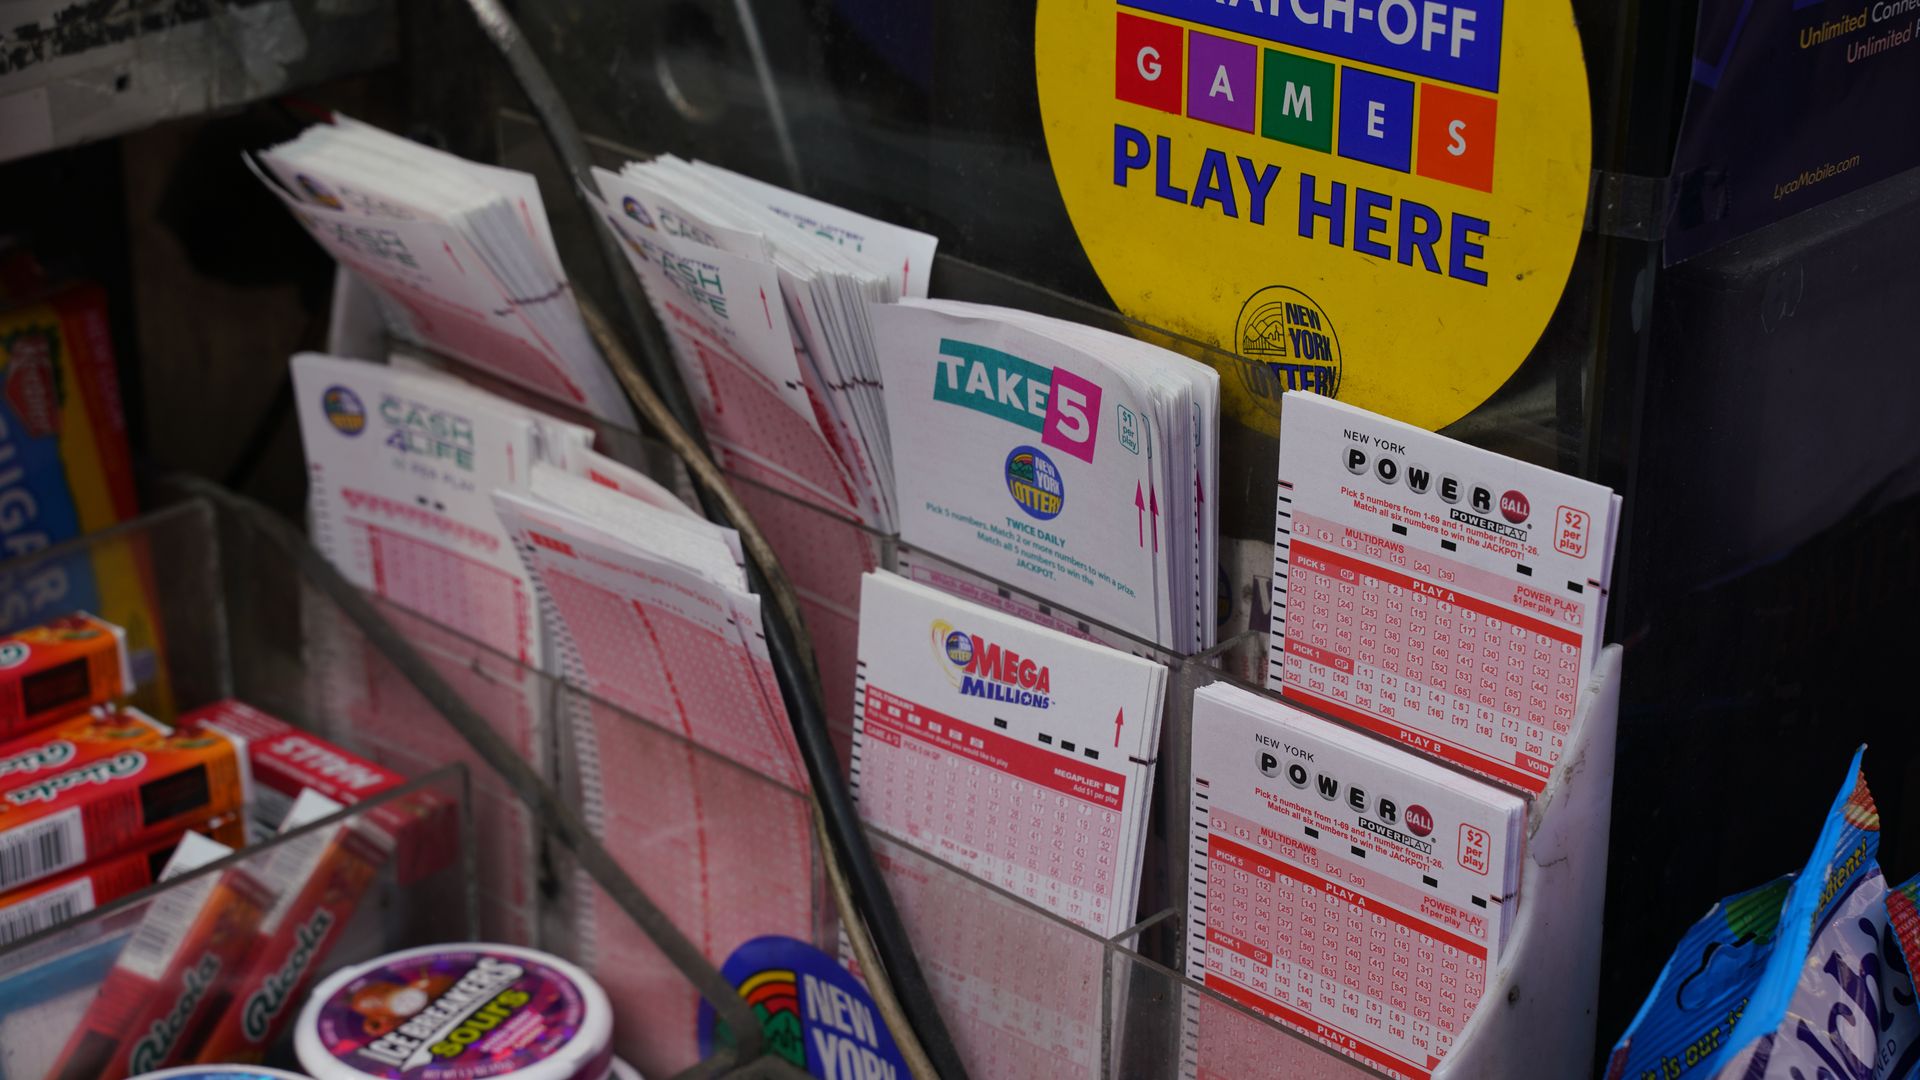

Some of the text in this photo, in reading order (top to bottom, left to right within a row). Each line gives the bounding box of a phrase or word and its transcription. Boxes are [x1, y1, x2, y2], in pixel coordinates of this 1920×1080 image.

[1800, 0, 1920, 49] Unlimited Conne
[1846, 21, 1913, 64] Unlimited
[1773, 153, 1860, 200] LycaMobile.com
[1113, 123, 1490, 287] PLAY HERE
[1285, 302, 1322, 332] NEW
[1288, 328, 1333, 362] YORK
[1122, 410, 1133, 427] $1
[1121, 434, 1138, 451] play
[1122, 426, 1135, 439] per
[1343, 428, 1406, 455] NEW YORK
[1034, 456, 1056, 478] NEW
[1036, 470, 1061, 496] YORK
[1009, 479, 1063, 515] LOTTERY
[1005, 516, 1066, 548] TWICE DAILY
[1341, 486, 1358, 498] Pick
[1359, 492, 1366, 501] 5
[1366, 495, 1401, 511] numbers
[1403, 505, 1421, 518] from
[1423, 512, 1440, 524] 1-69
[1442, 518, 1457, 530] and
[1466, 526, 1498, 543] number
[1499, 536, 1519, 549] from
[1521, 543, 1540, 557] 1-26.
[1353, 500, 1525, 562] Match all six numbers to win the JACKPOT!
[1564, 511, 1583, 530] $2
[1344, 527, 1405, 554] MULTIDRAWS
[1559, 539, 1582, 554] play
[1562, 528, 1582, 541] per
[1021, 549, 1056, 570] numbers
[1057, 563, 1066, 573] to
[1032, 541, 1053, 555] more
[1054, 549, 1088, 572] numbers
[1088, 565, 1097, 576] to
[1097, 571, 1112, 584] win
[1297, 556, 1320, 569] PICK
[1320, 563, 1326, 571] 5
[1412, 580, 1456, 604] PLAY A
[1516, 585, 1579, 613] POWER PLAY
[1538, 602, 1556, 617] play
[963, 633, 1051, 695] MEGA
[1292, 643, 1314, 658] PICK
[960, 675, 1051, 709] MILLIONS
[1255, 733, 1316, 763] NEW YORK
[1400, 731, 1442, 753] PLAY B
[1526, 758, 1549, 773] VOID
[1073, 784, 1086, 793] Add
[1086, 788, 1094, 796] $1
[1094, 791, 1105, 800] per
[1255, 787, 1271, 800] Pick
[1272, 794, 1278, 803] 5
[1279, 797, 1313, 816] numbers
[1314, 810, 1332, 824] from
[1333, 818, 1349, 832] 1-69
[1351, 826, 1366, 838] and
[1374, 835, 1404, 853] number
[1405, 846, 1424, 862] from
[1426, 856, 1445, 871] 1-26.
[1260, 826, 1317, 856] MULTIDRAWS
[1267, 801, 1431, 873] Match all six numbers to win the JACKPOT!
[1466, 829, 1484, 848] $2
[1216, 850, 1244, 867] PICK 5
[1462, 854, 1485, 871] play
[1465, 846, 1483, 858] per
[1325, 883, 1366, 907] PLAY A
[1423, 896, 1483, 926] POWER PLAY
[1444, 914, 1461, 929] play
[1214, 932, 1234, 947] PICK
[242, 906, 335, 1042] Ricola
[130, 954, 221, 1076] Ricola
[399, 957, 524, 1052] BREAKERS
[803, 973, 879, 1049] NEW
[1317, 1025, 1358, 1051] PLAY B
[1685, 1027, 1722, 1068] our
